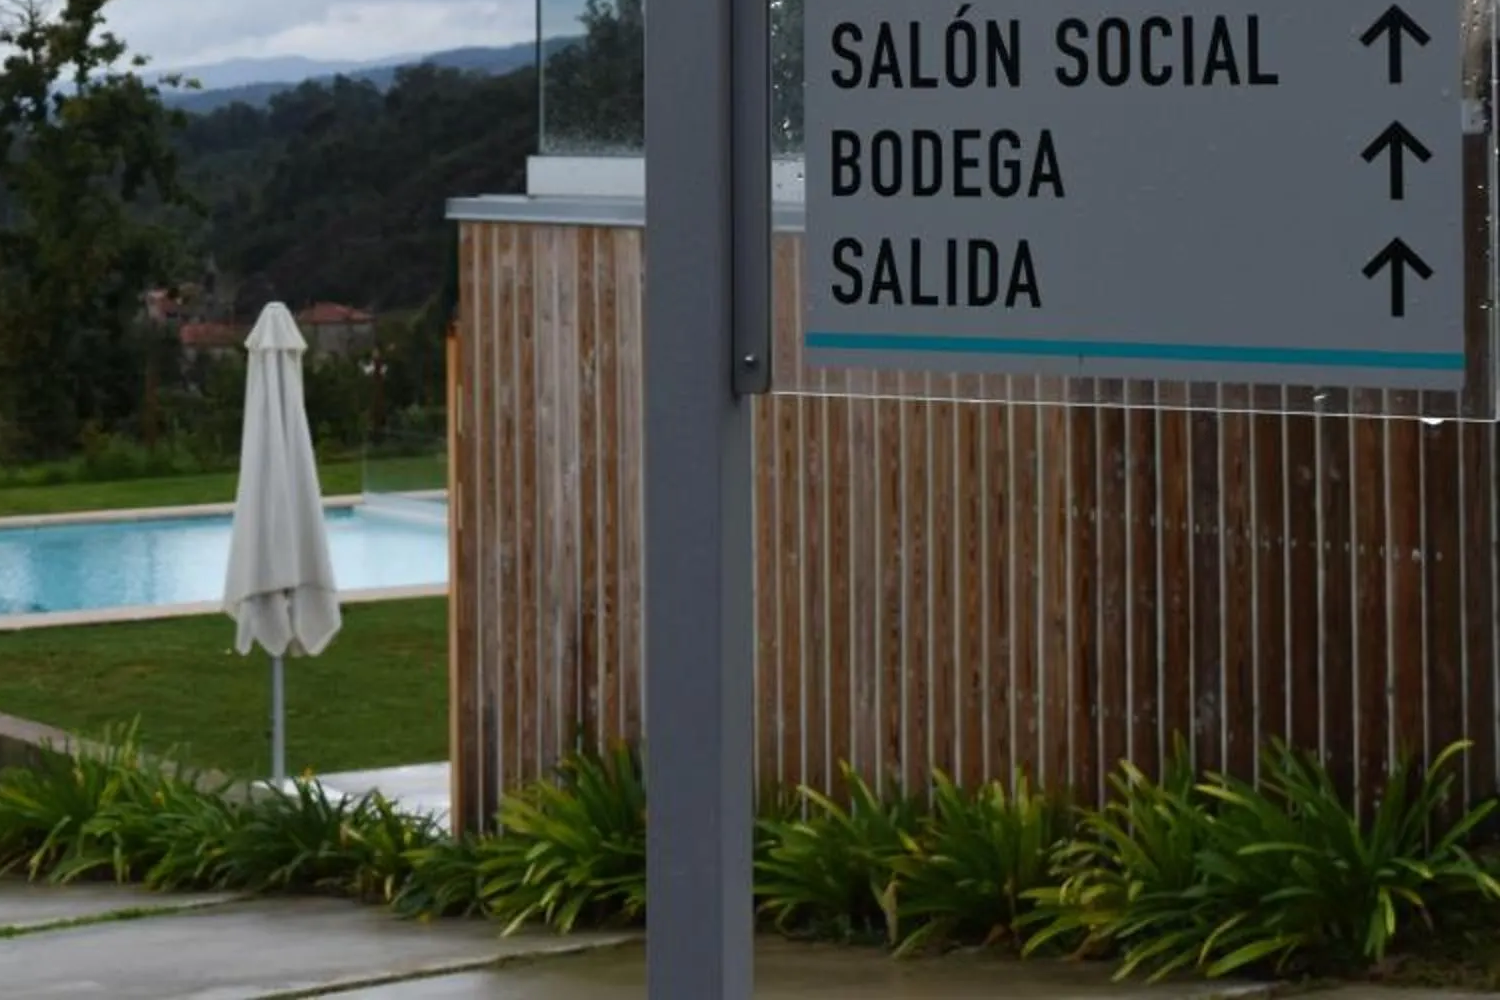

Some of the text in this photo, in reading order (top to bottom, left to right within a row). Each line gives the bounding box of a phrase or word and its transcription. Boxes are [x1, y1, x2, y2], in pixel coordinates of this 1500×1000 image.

[831, 3, 1279, 90] SALÓN SOCIAL
[831, 128, 1065, 199] BODEGA
[831, 237, 1042, 309] SALIDA
